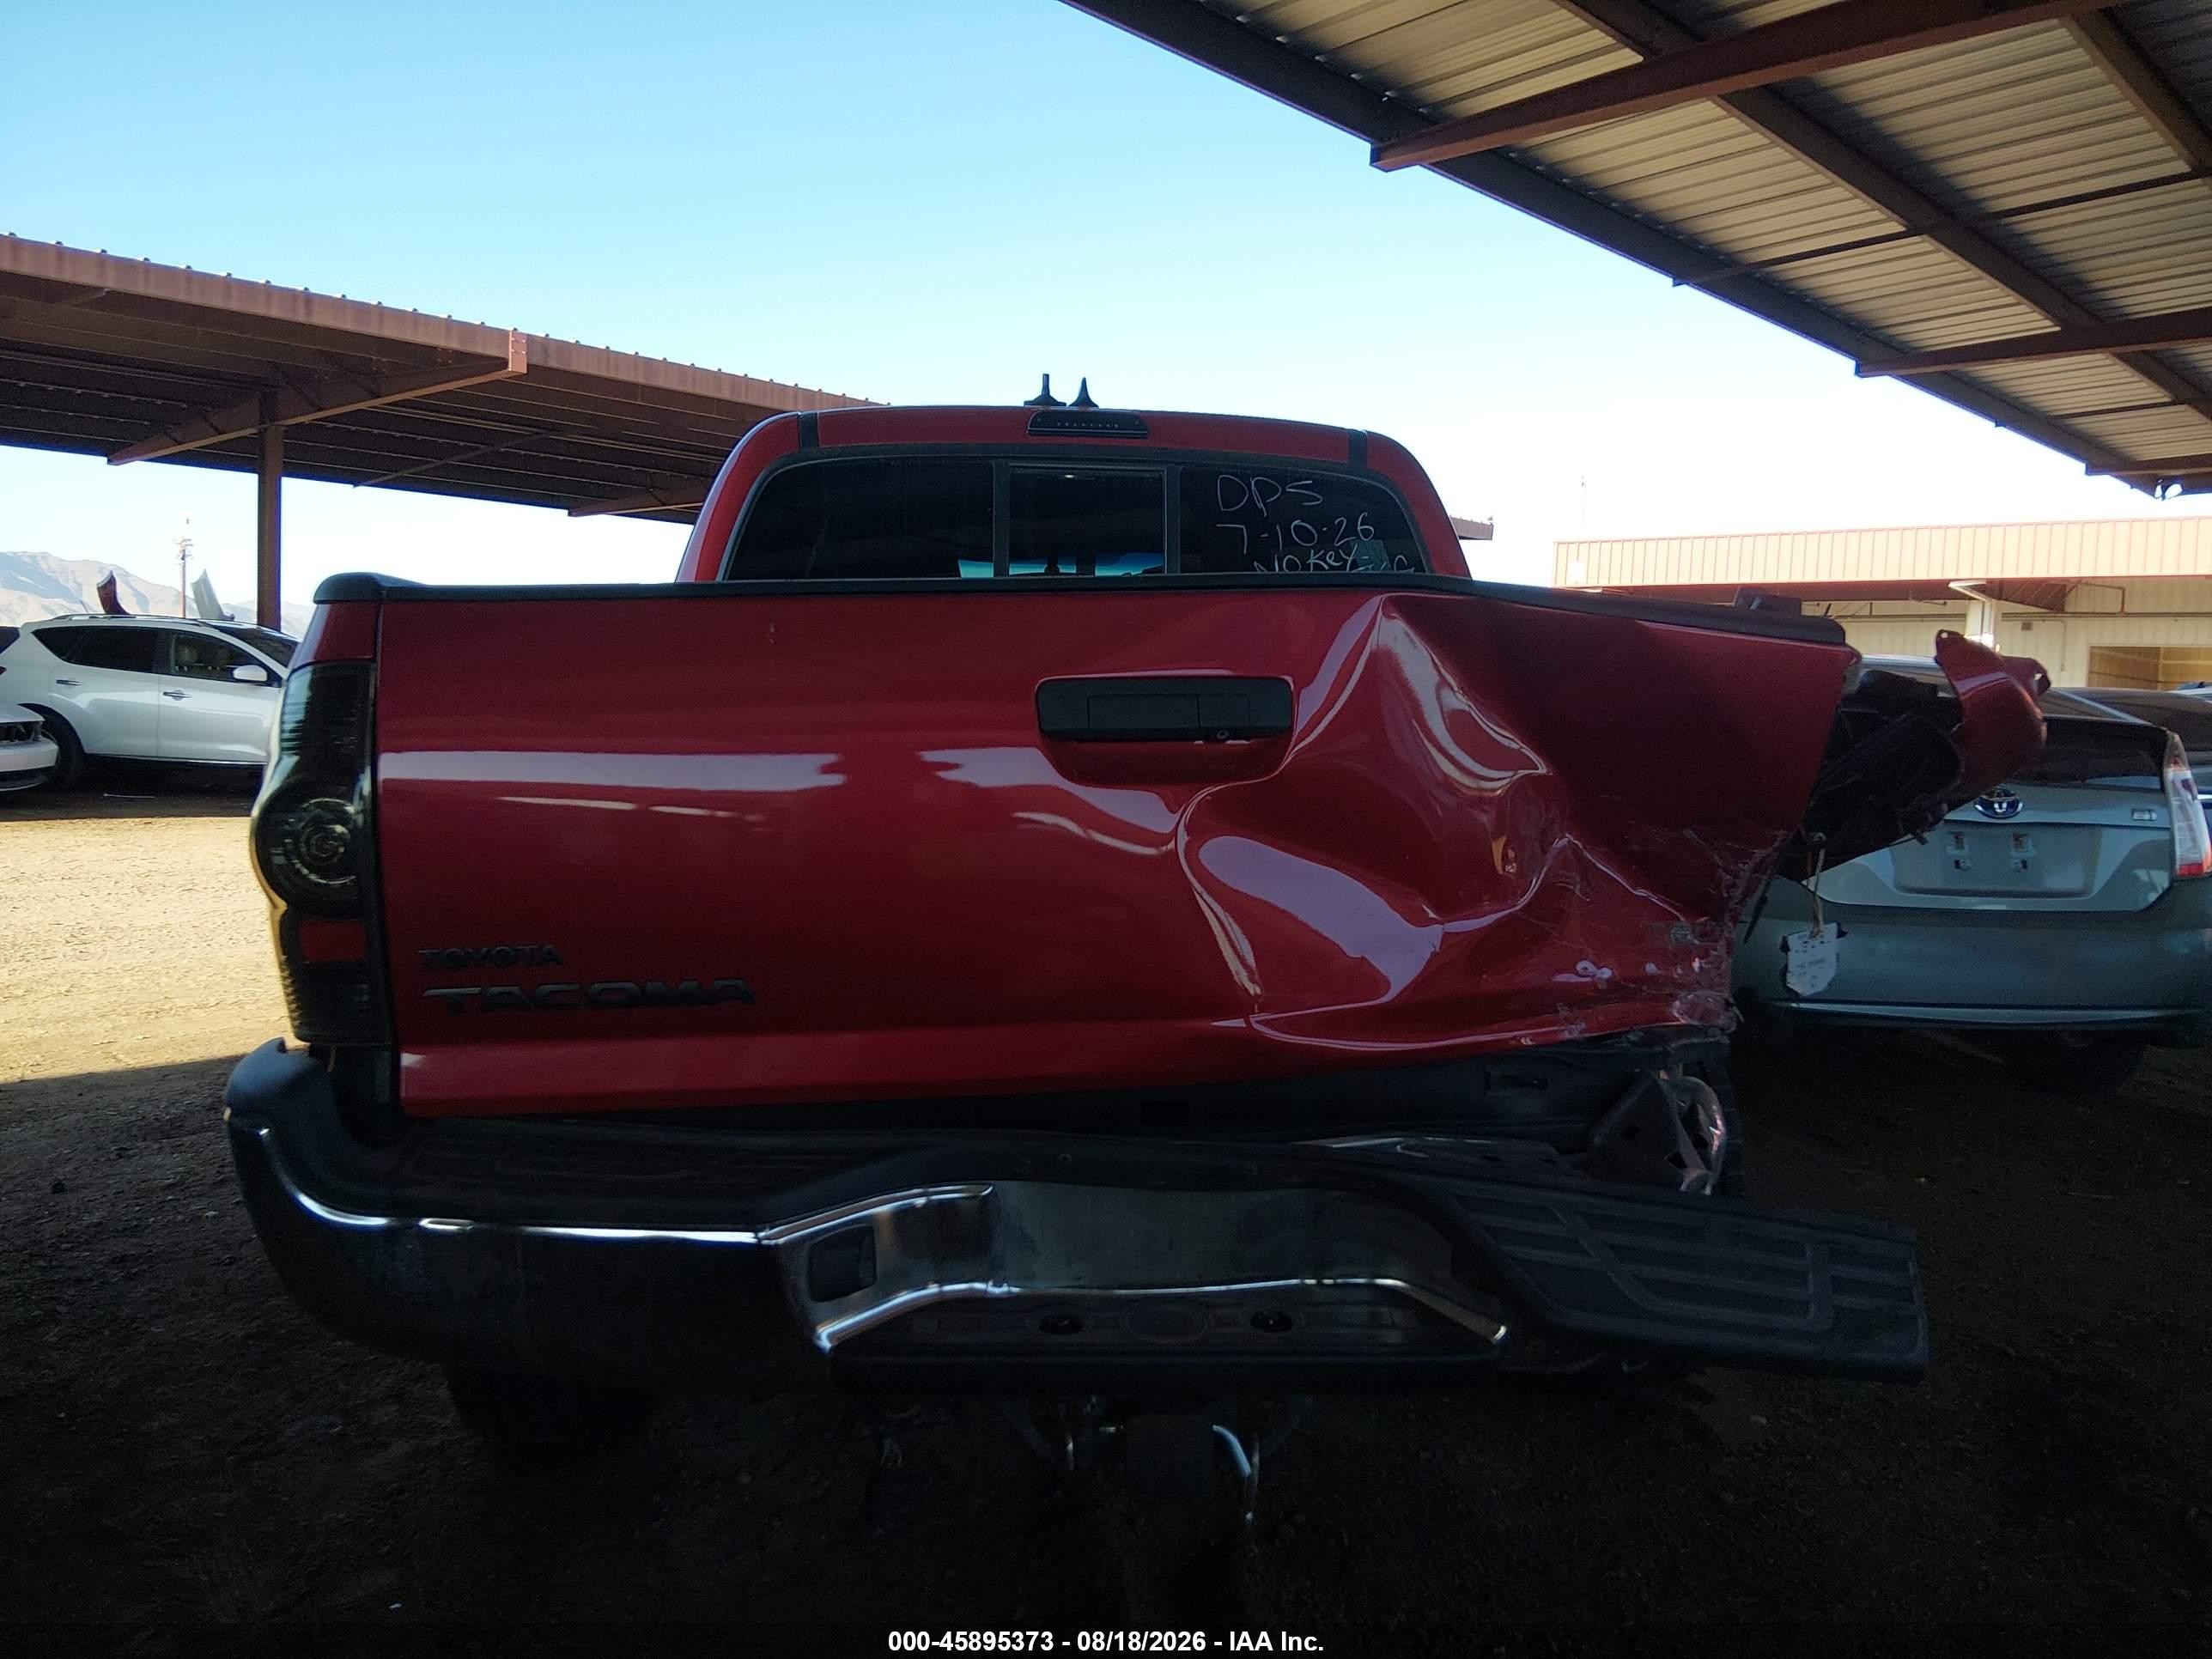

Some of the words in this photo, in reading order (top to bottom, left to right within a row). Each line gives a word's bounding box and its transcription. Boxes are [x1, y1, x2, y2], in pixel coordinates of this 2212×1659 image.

[1218, 474, 1323, 517] DPS
[417, 945, 563, 969] TOYOTA
[422, 979, 757, 1015] TACOMA
